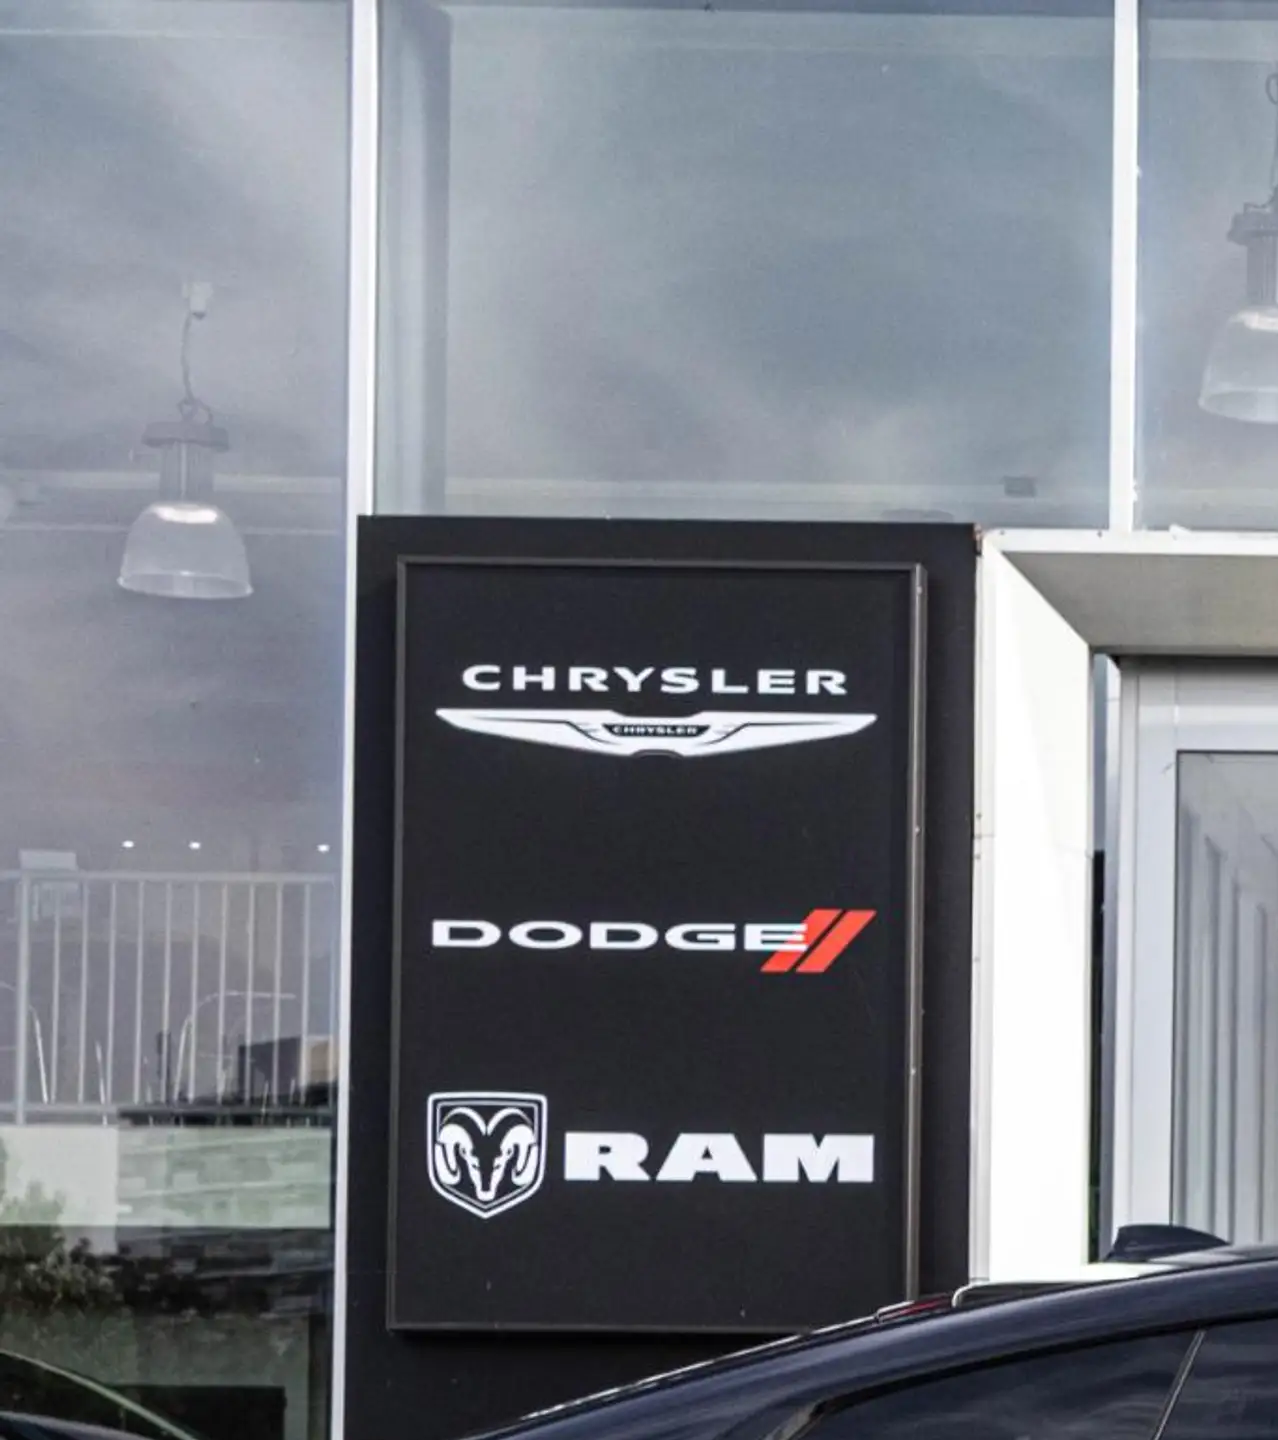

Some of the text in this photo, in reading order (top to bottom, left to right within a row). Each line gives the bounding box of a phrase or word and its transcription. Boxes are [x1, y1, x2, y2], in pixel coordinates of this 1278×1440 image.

[462, 664, 848, 696] CHRYSLER
[611, 724, 699, 737] CHRYSLER
[431, 919, 809, 953] DODGE
[563, 1131, 876, 1184] RAM
